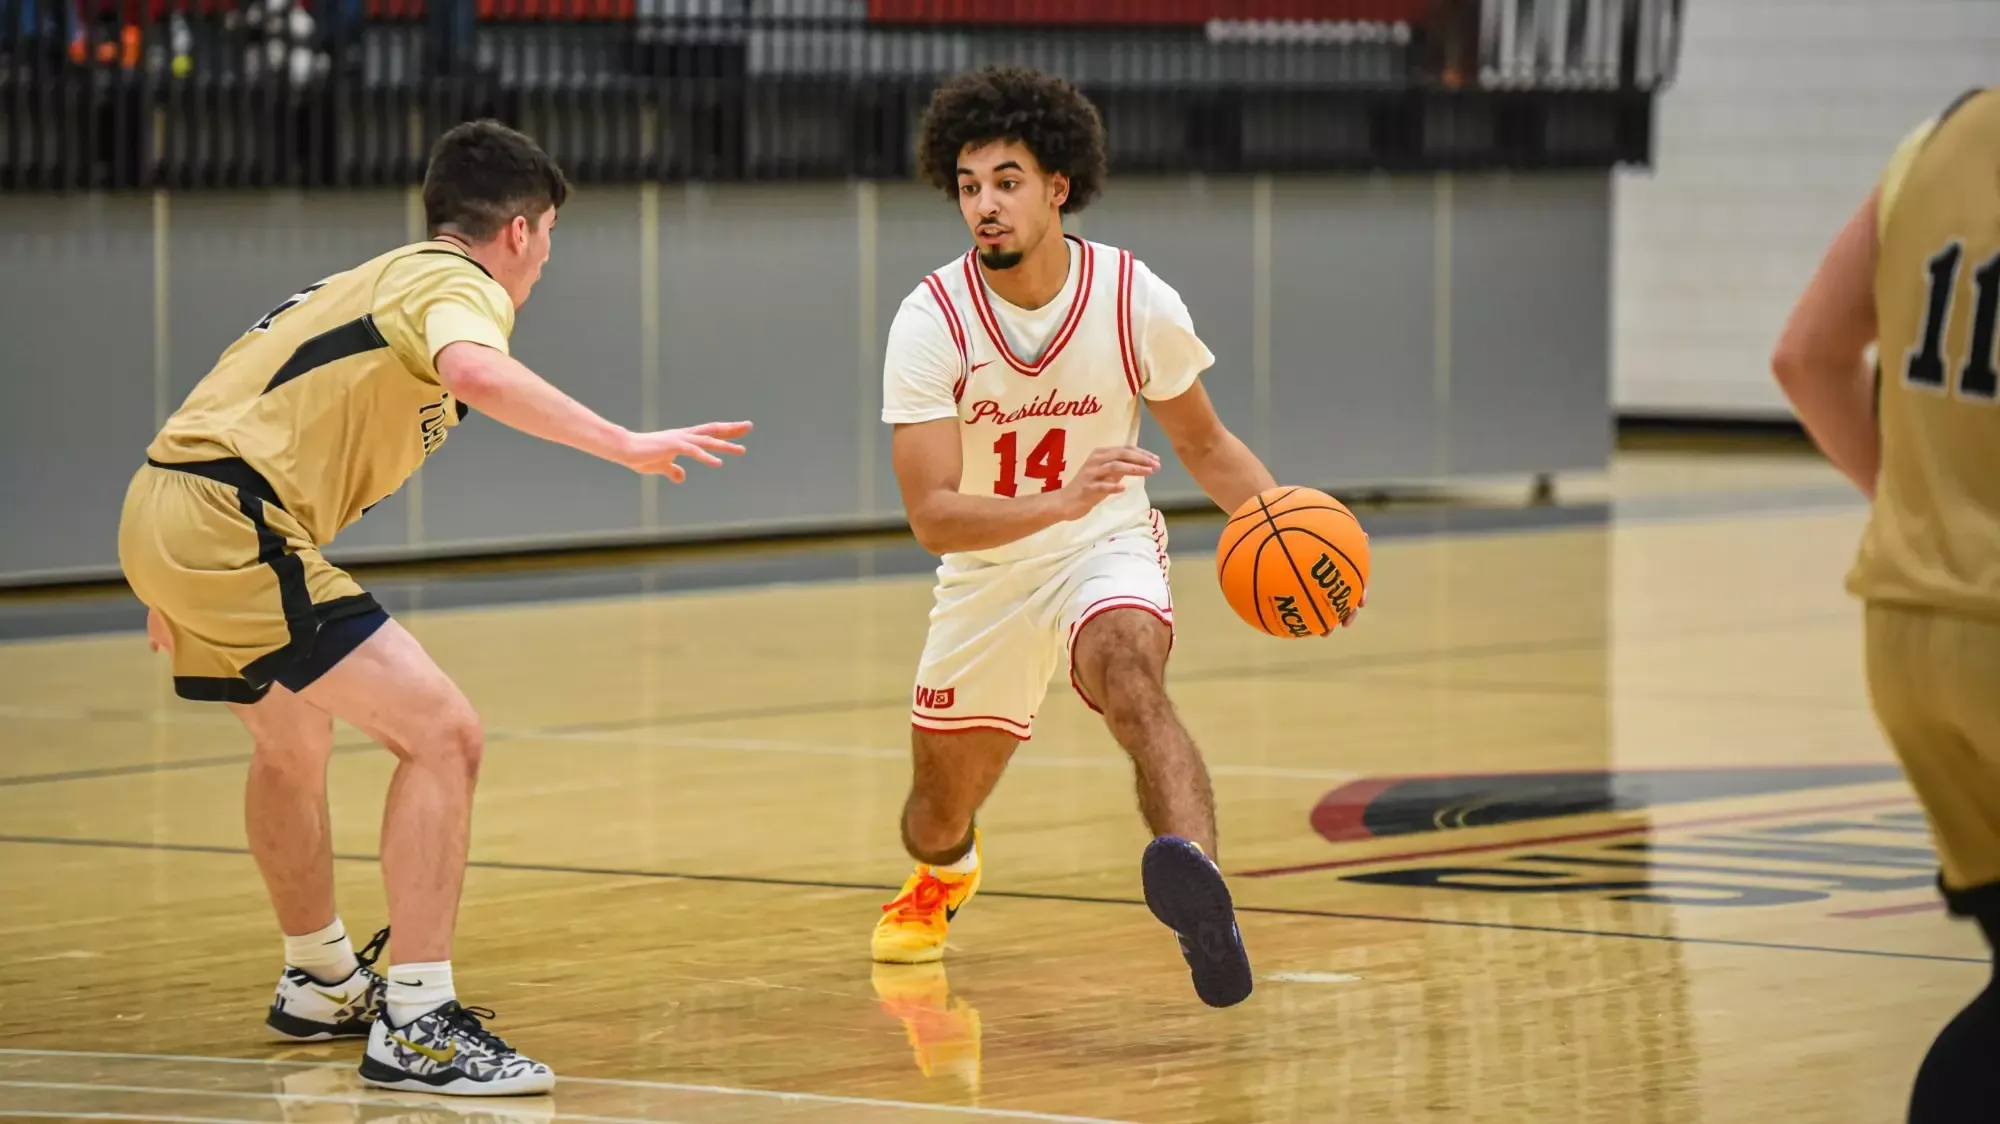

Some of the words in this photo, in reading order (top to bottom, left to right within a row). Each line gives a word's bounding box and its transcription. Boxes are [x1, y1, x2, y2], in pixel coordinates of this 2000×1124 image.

[1904, 239, 2000, 402] 11
[965, 388, 1103, 425] Presidents
[993, 428, 1067, 499] 14
[1311, 552, 1352, 623] Wilso
